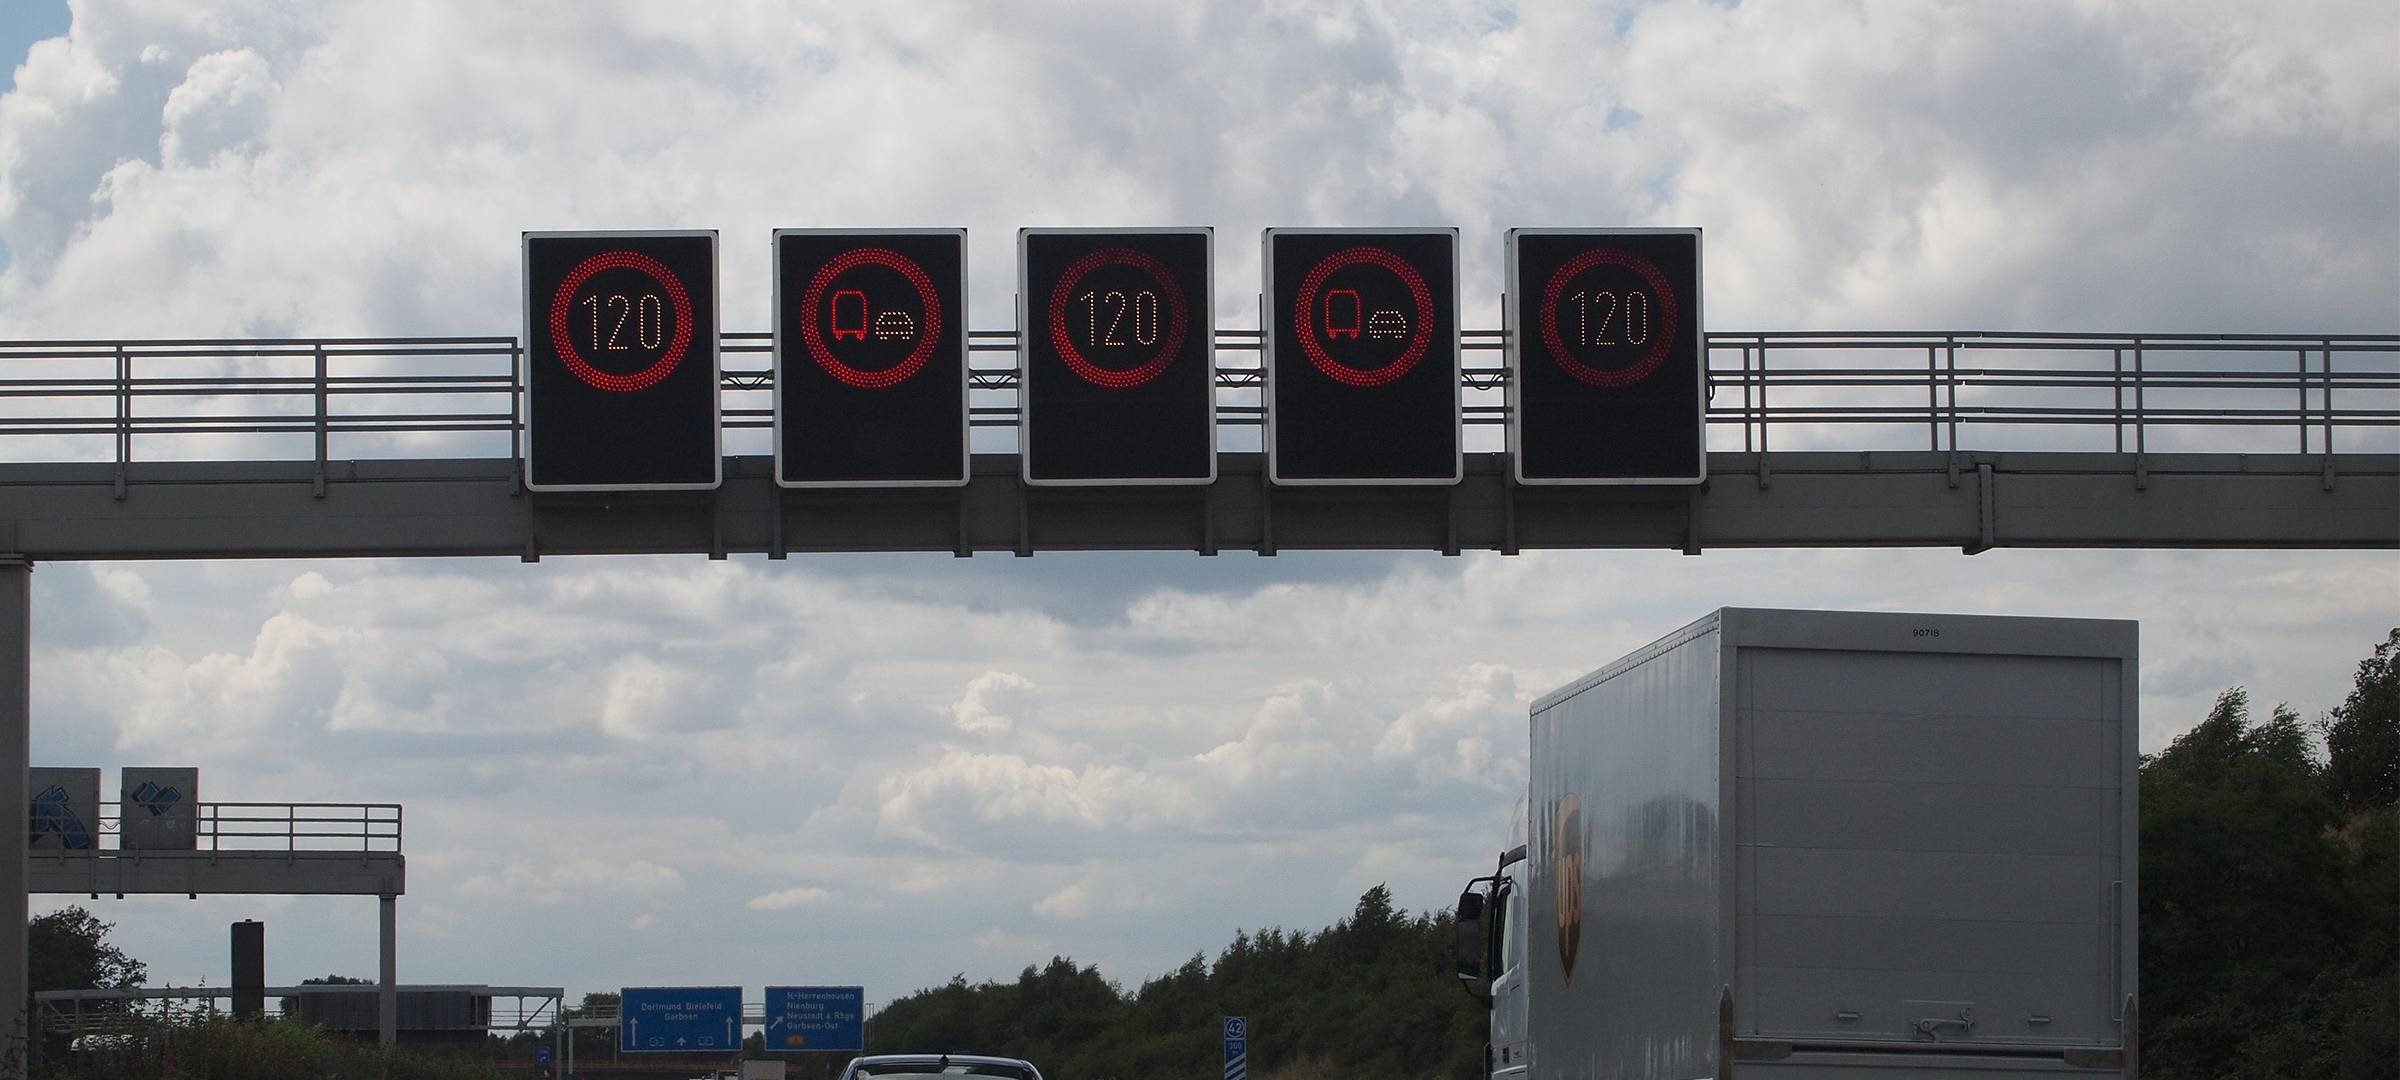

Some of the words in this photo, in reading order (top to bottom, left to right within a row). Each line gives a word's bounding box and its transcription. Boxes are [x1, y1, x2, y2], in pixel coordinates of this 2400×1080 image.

[583, 294, 661, 350] 120
[1080, 291, 1157, 346] 120
[1571, 291, 1647, 346] 120
[641, 1002, 681, 1010] Dortmund
[686, 1002, 722, 1010] Bielefeld
[787, 1002, 824, 1011] Nienburg
[1228, 1023, 1242, 1033] 42
